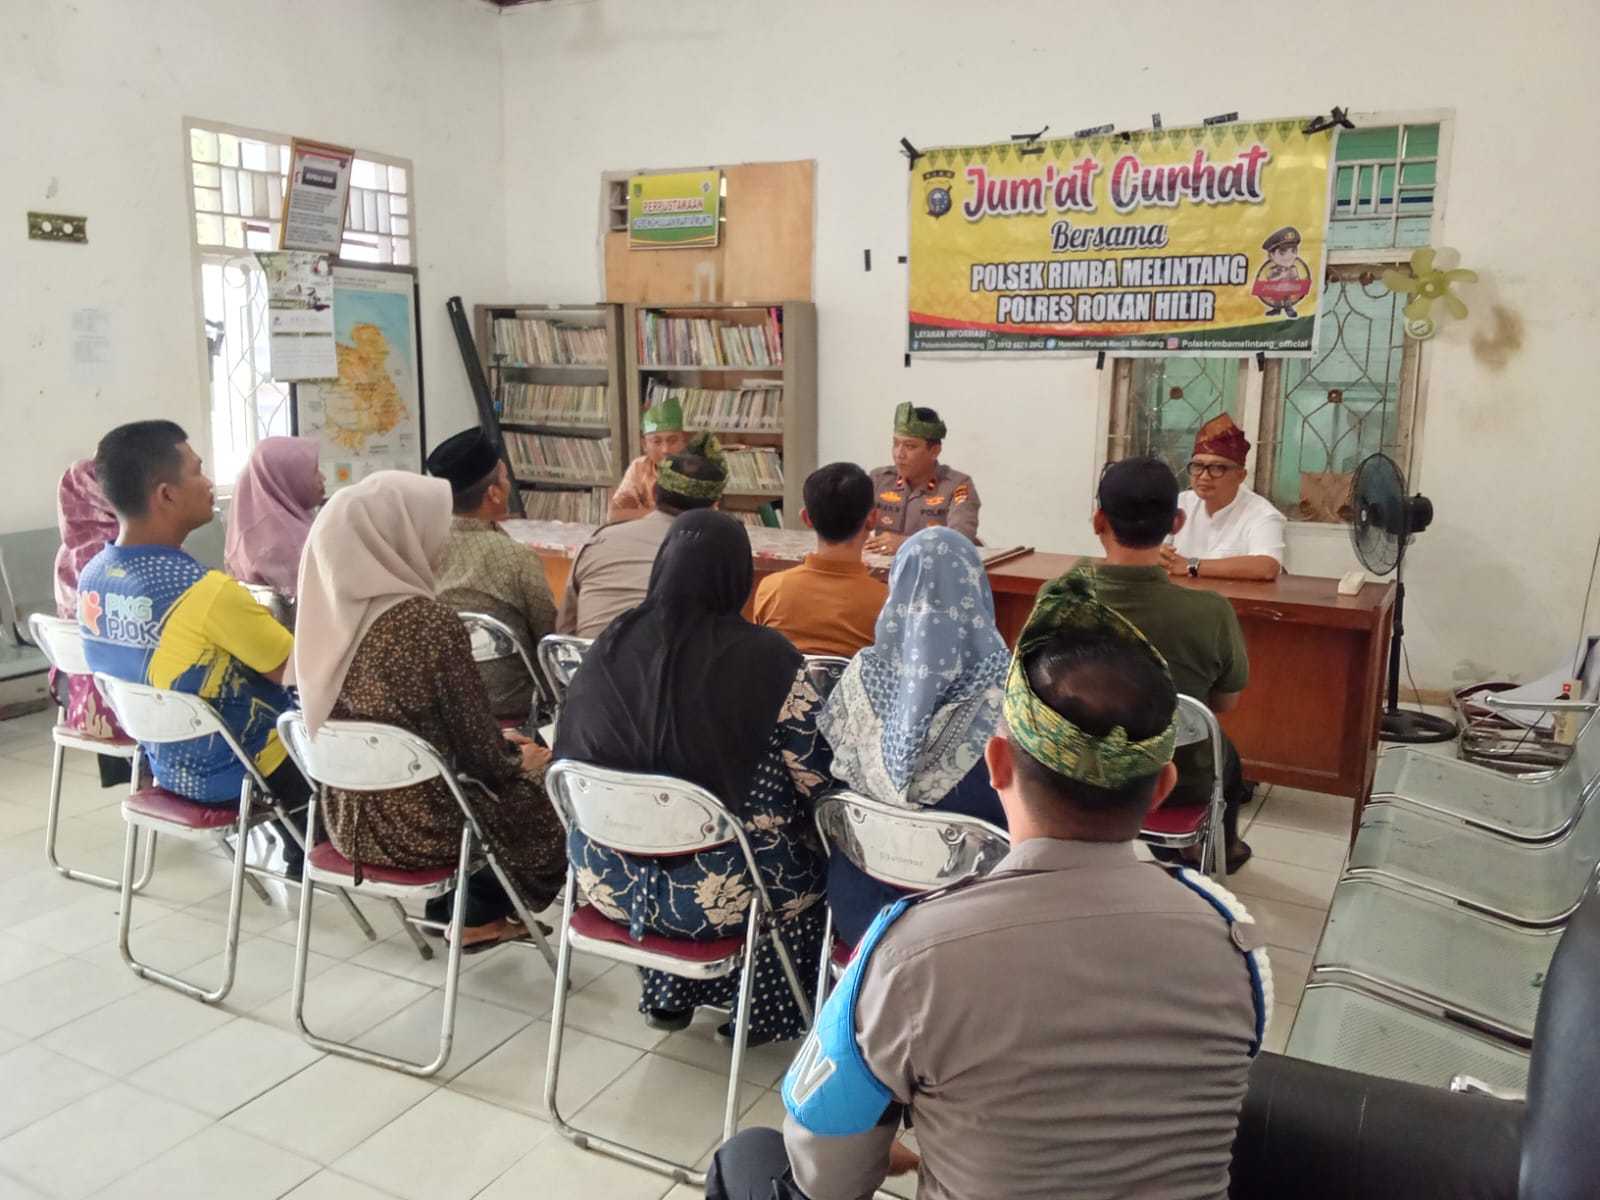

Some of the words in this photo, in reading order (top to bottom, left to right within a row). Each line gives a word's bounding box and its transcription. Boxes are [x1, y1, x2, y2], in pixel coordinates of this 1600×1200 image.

[965, 158, 1099, 219] Jum'at
[1111, 145, 1268, 210] Curhat
[643, 199, 703, 212] PERPUSTAKAAN
[1052, 221, 1167, 251] Bersama
[971, 264, 1045, 291] POLSEK
[1048, 260, 1118, 288] RIMBA
[1119, 254, 1248, 287] MELINTANG
[998, 297, 1075, 323] POLRES
[1077, 294, 1152, 322] ROKAN
[1155, 292, 1215, 320] HILIR
[914, 330, 945, 338] LAYANAN
[946, 330, 987, 338] INFORMASI
[1181, 339, 1309, 350] Polsekrimbamelintang_official
[105, 593, 153, 621] PKG
[107, 616, 160, 644] PJOK
